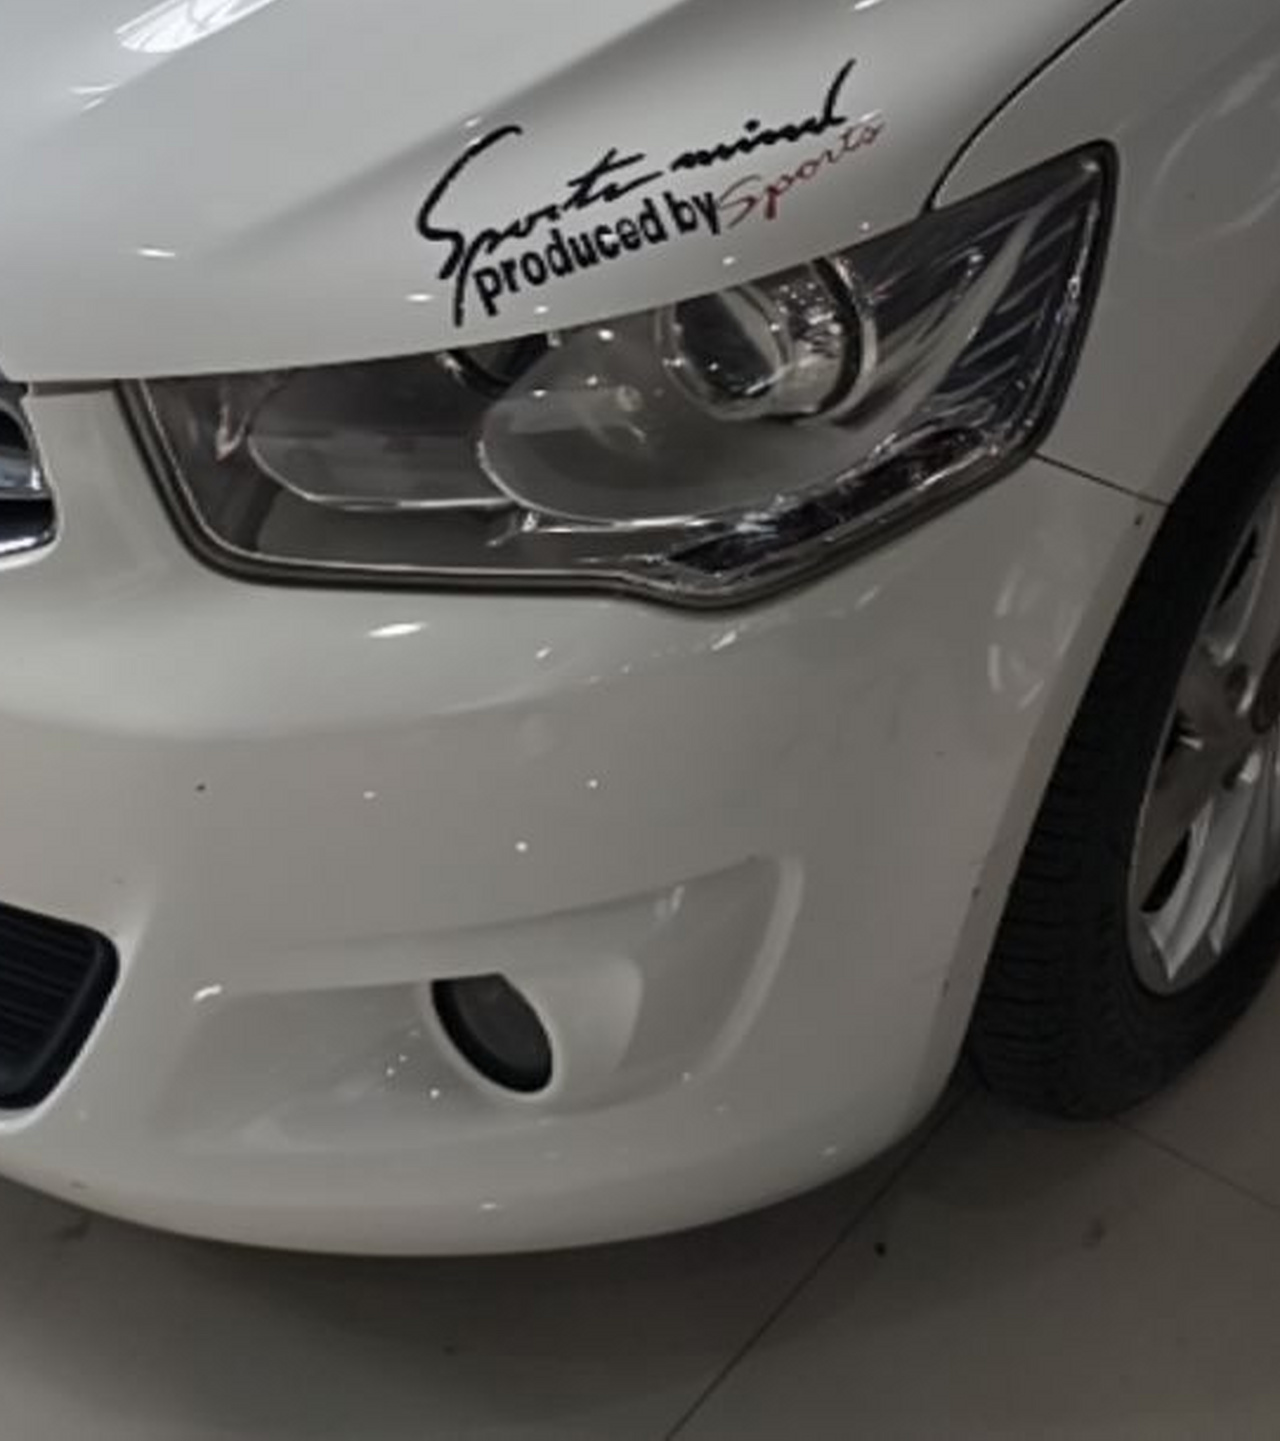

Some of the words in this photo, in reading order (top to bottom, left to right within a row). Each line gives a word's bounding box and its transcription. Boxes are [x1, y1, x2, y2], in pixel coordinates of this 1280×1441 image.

[670, 59, 856, 171] mind
[472, 194, 669, 317] produced
[669, 188, 721, 234] by
[719, 120, 886, 229] Sports
